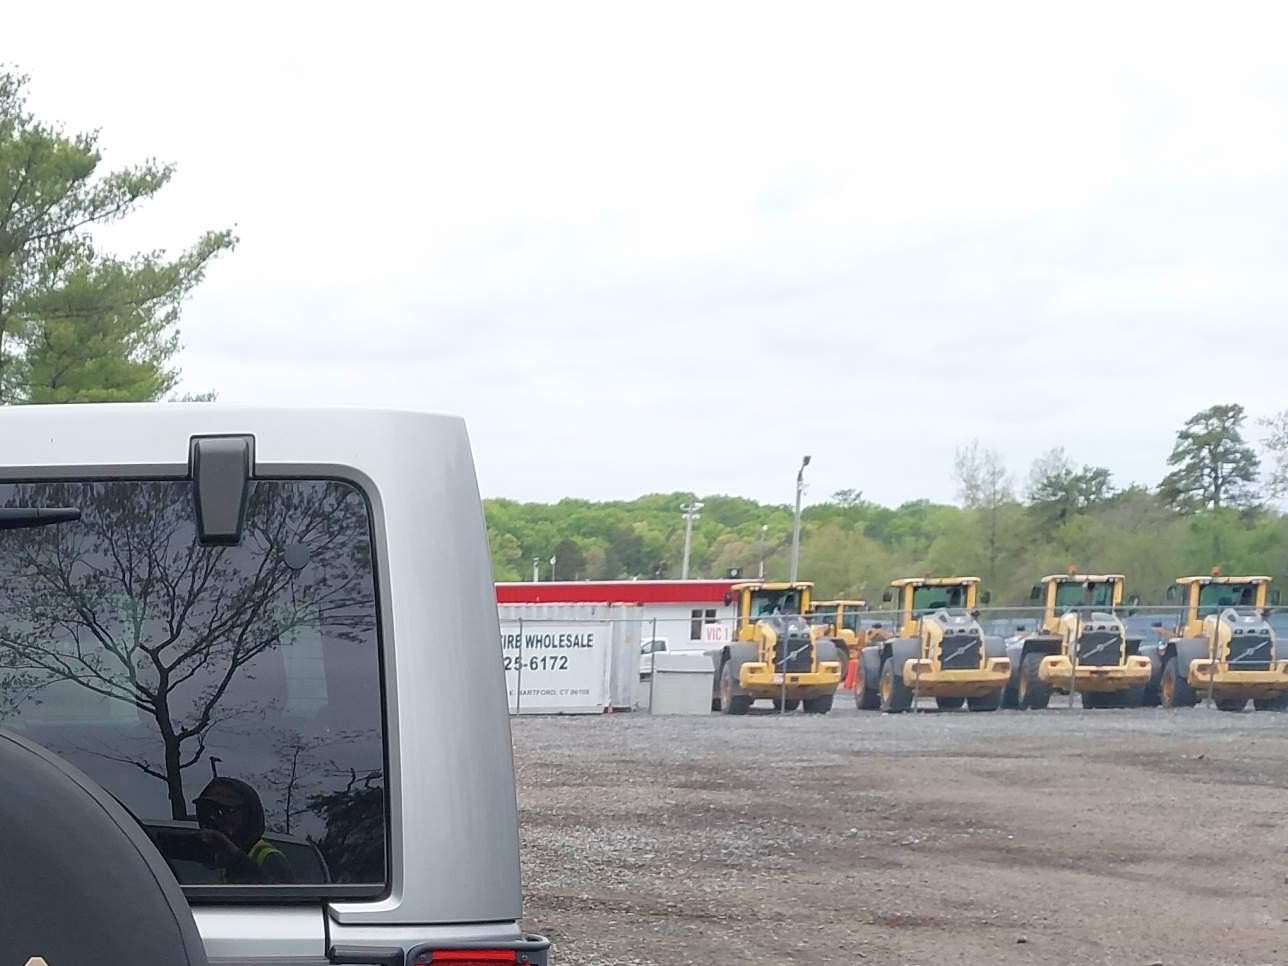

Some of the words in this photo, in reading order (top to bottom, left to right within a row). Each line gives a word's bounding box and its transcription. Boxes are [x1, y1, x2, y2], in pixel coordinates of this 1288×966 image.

[501, 634, 521, 649] IRE
[525, 633, 594, 648] WHOLESALE
[706, 627, 722, 641] VIC
[504, 655, 568, 671] 25-6172
